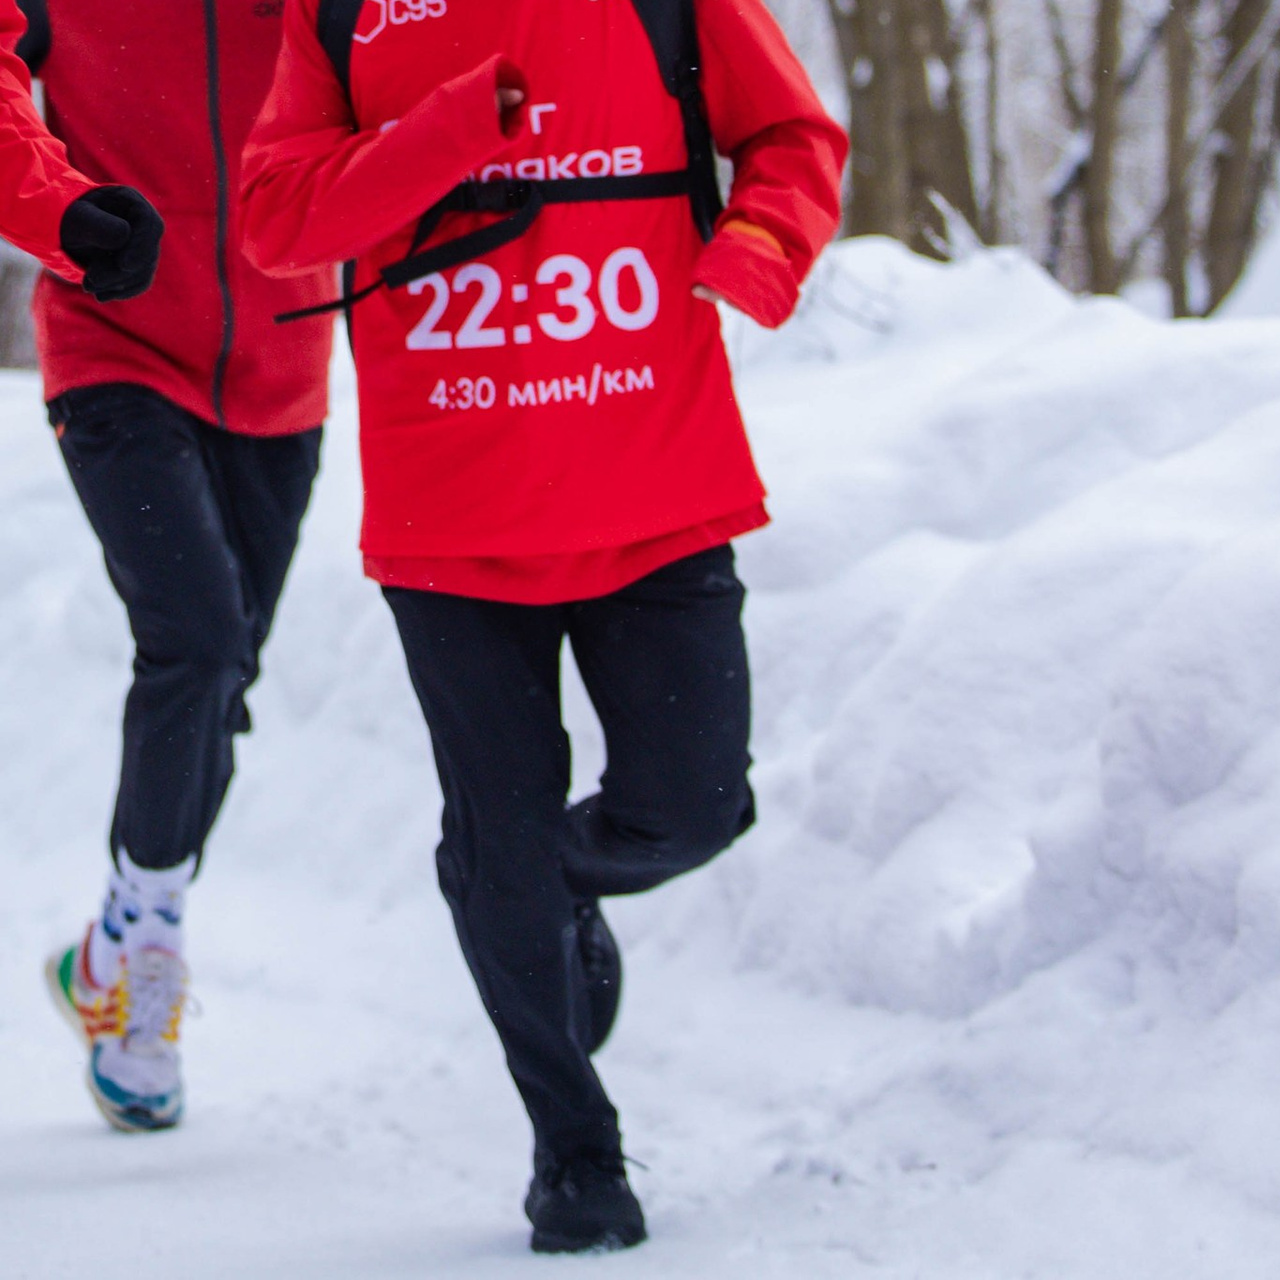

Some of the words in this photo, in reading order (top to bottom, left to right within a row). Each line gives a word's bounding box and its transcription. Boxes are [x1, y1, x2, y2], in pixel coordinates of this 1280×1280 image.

[464, 145, 644, 184] аяков
[405, 246, 660, 351] 22:30
[428, 376, 497, 410] 4:30
[508, 363, 655, 407] мин/км
